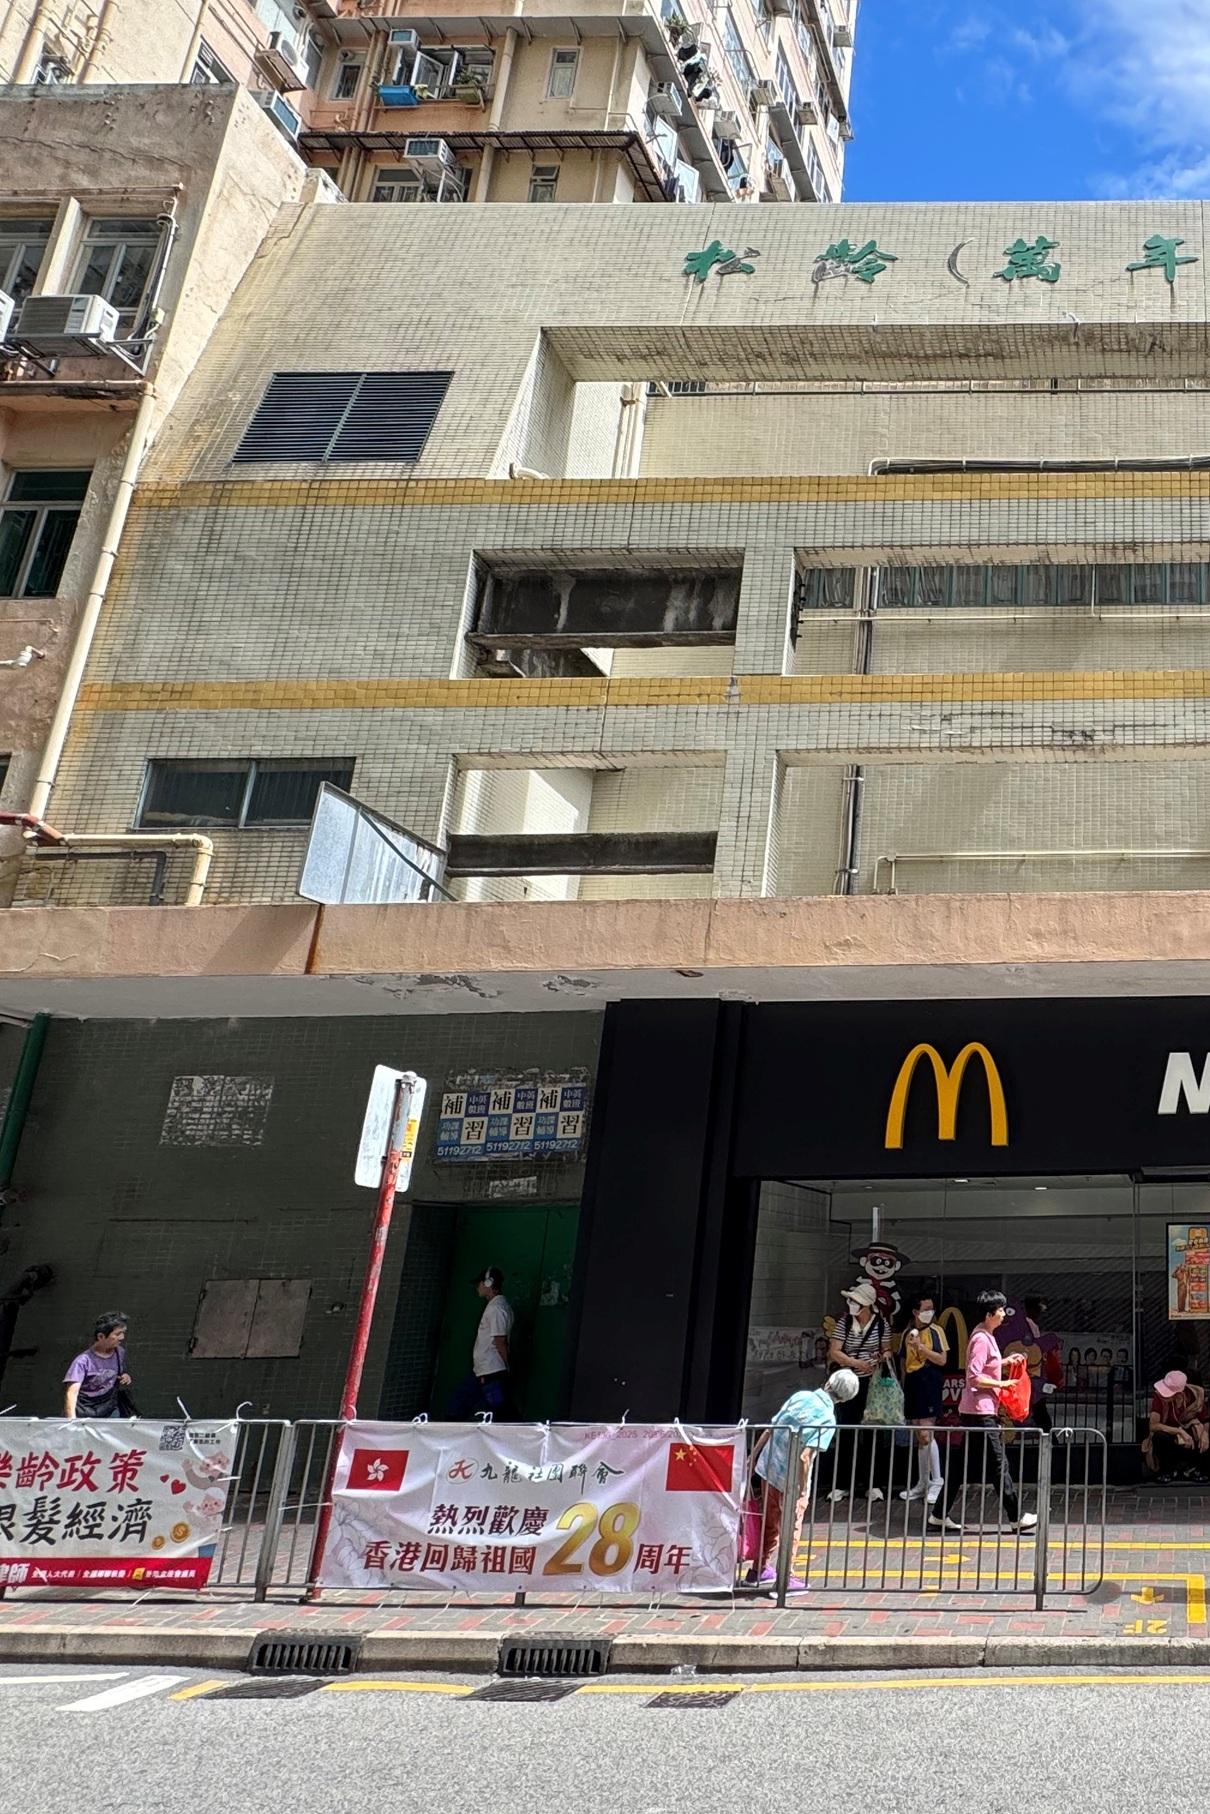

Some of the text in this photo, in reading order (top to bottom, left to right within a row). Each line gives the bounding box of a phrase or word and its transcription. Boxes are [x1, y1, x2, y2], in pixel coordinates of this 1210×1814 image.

[445, 1095, 463, 1115] 補
[493, 1091, 511, 1110] 補
[540, 1090, 559, 1109] 補
[465, 1121, 484, 1140] 習
[514, 1116, 533, 1136] 習
[561, 1115, 579, 1134] 習
[437, 1146, 482, 1156] 51192712
[486, 1141, 531, 1151] 51192712
[534, 1140, 579, 1150] 51192712
[942, 1378, 966, 1388] ARS
[427, 1504, 549, 1536] 熱烈歡慶
[363, 1501, 695, 1578] 香港回歸祖國 28 周年
[1122, 1619, 1168, 1634] 2F
